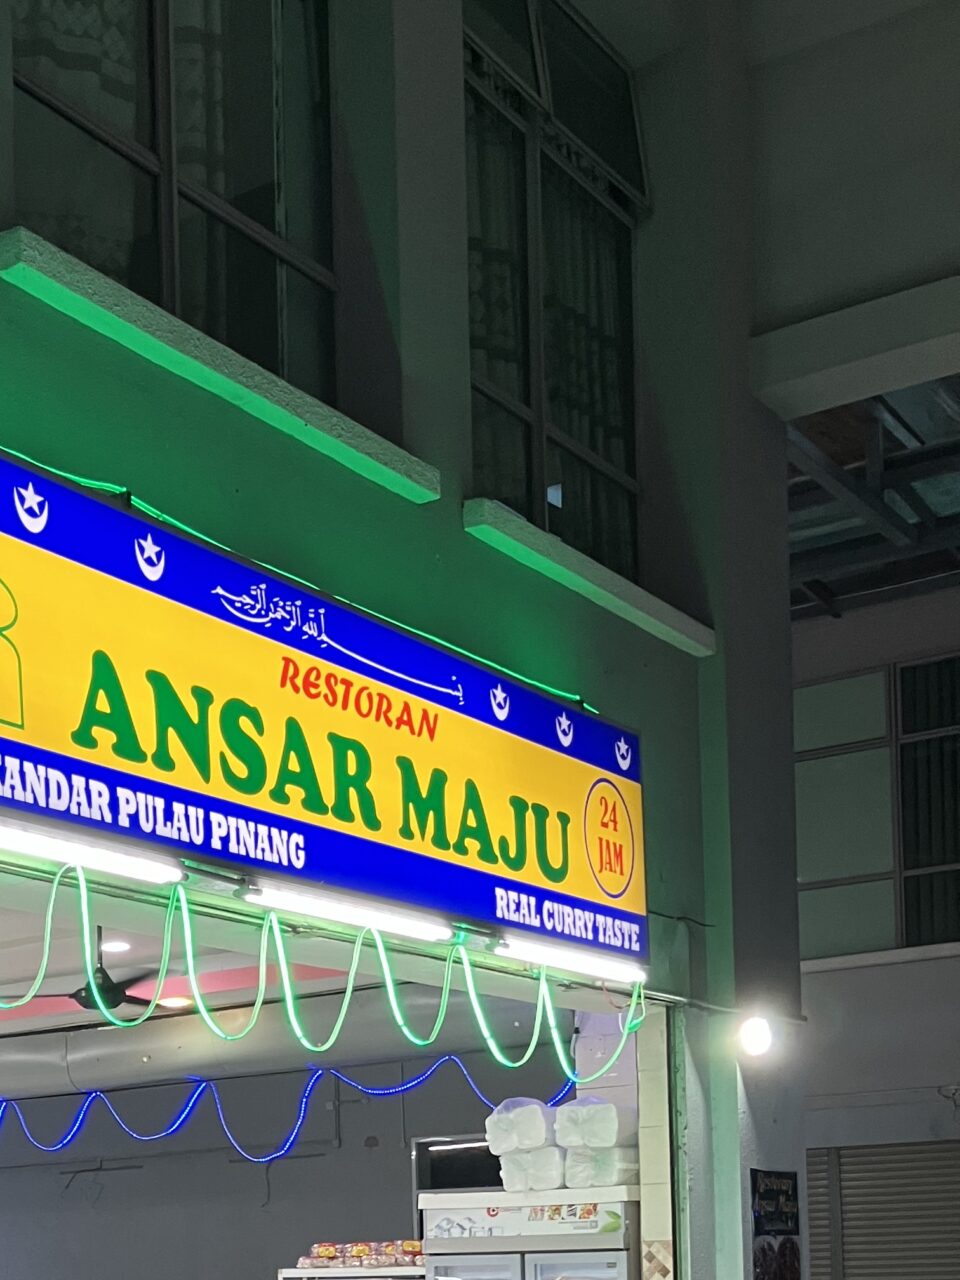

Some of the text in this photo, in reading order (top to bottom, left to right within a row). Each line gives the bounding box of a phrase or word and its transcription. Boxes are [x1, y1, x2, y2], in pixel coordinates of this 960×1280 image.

[279, 656, 439, 742] RESTORAN
[70, 649, 571, 883] ANSAR MAJU
[117, 786, 205, 846] PULAU
[209, 812, 306, 869] PINANG
[599, 796, 619, 832] 24
[597, 836, 625, 876] JAM
[494, 886, 640, 952] REAL CURRY TASTE
